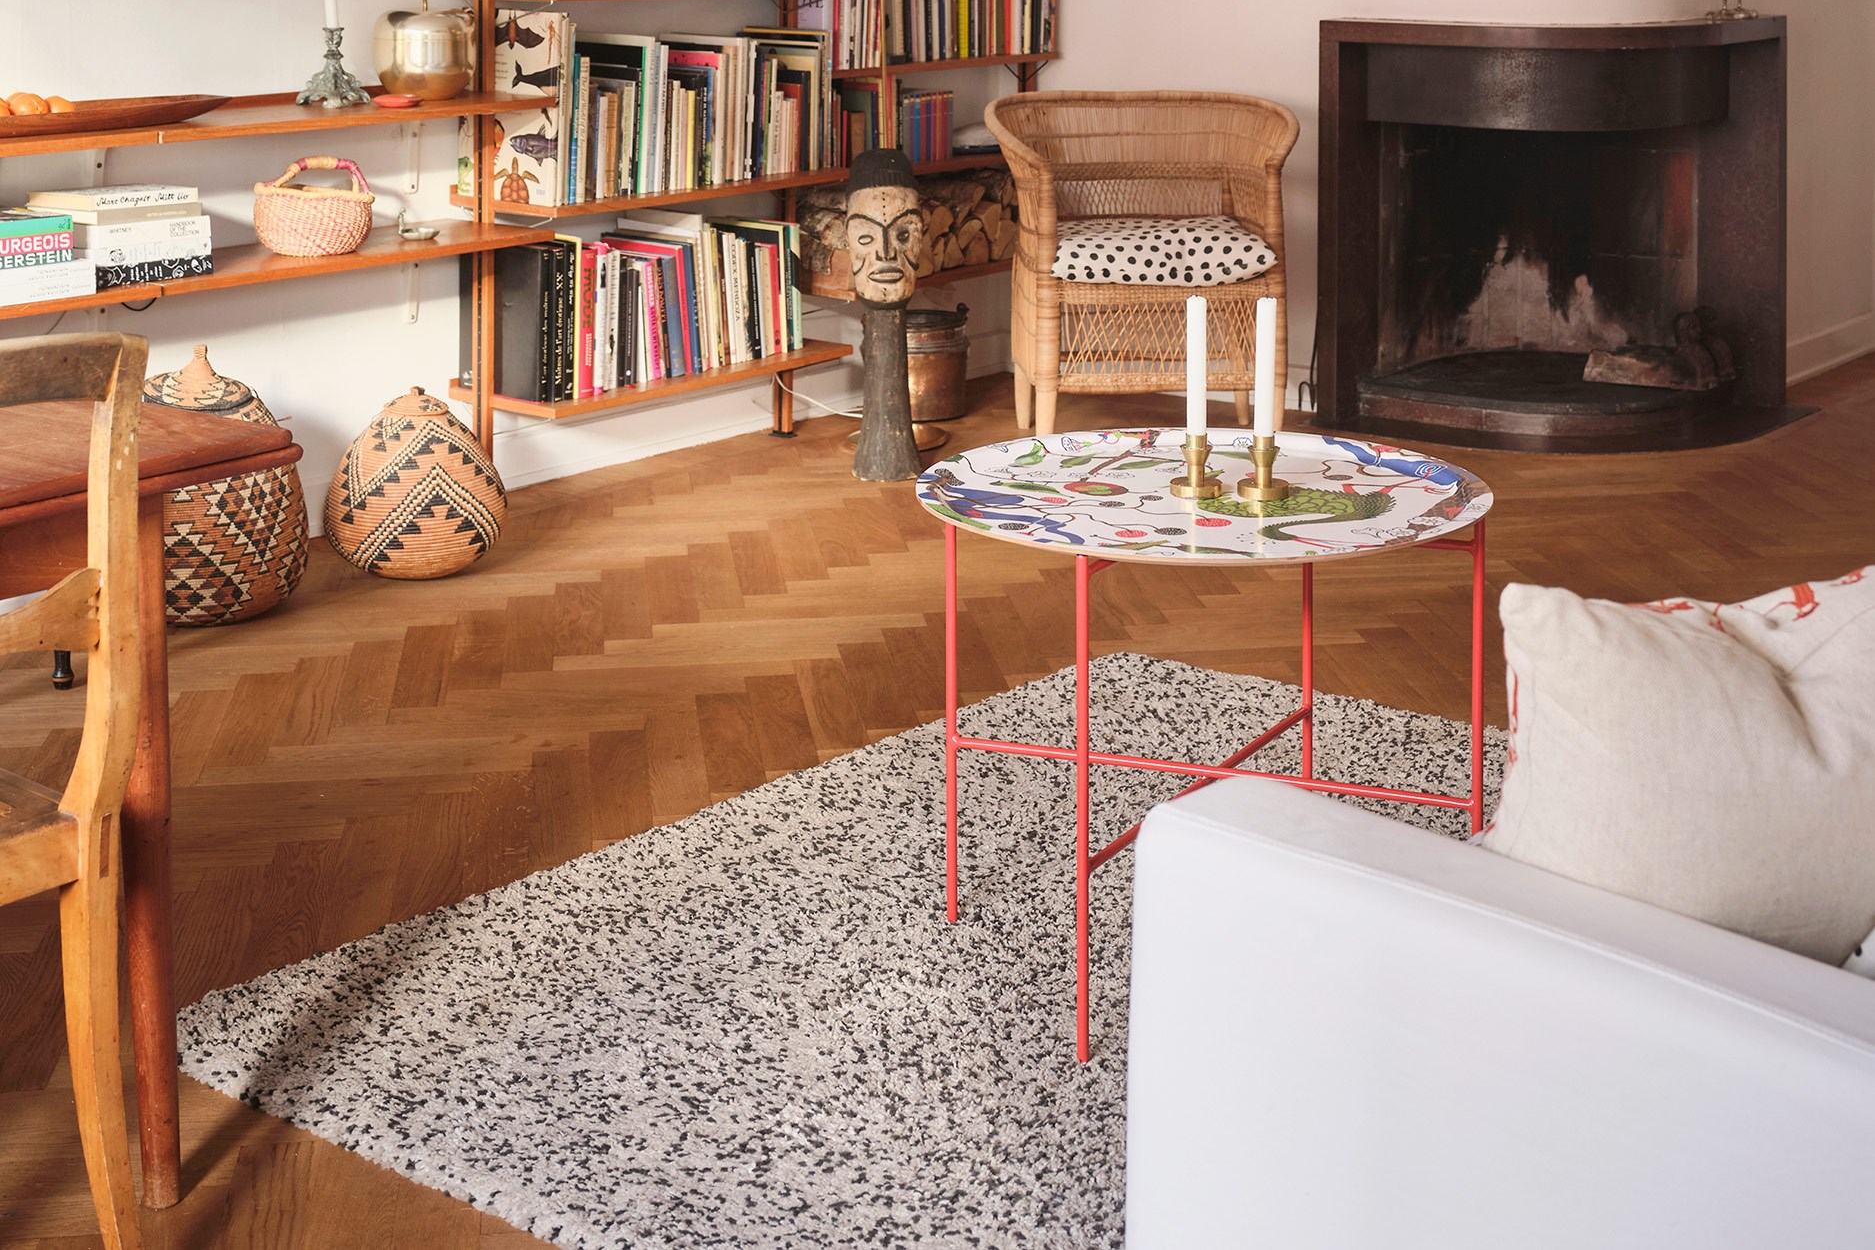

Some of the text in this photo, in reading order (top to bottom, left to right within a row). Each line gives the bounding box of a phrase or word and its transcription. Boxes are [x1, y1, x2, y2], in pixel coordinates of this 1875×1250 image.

[774, 124, 780, 133] är
[169, 220, 196, 228] HANDBOOK
[169, 230, 200, 238] COLLECTION
[730, 243, 741, 322] CODEX MENDOZA
[582, 267, 595, 329] MODE
[556, 297, 564, 328] érotique
[555, 329, 563, 345] l'art
[555, 345, 563, 355] de
[651, 327, 660, 371] LEWENHAUPT
[554, 355, 563, 385] Maîtres
